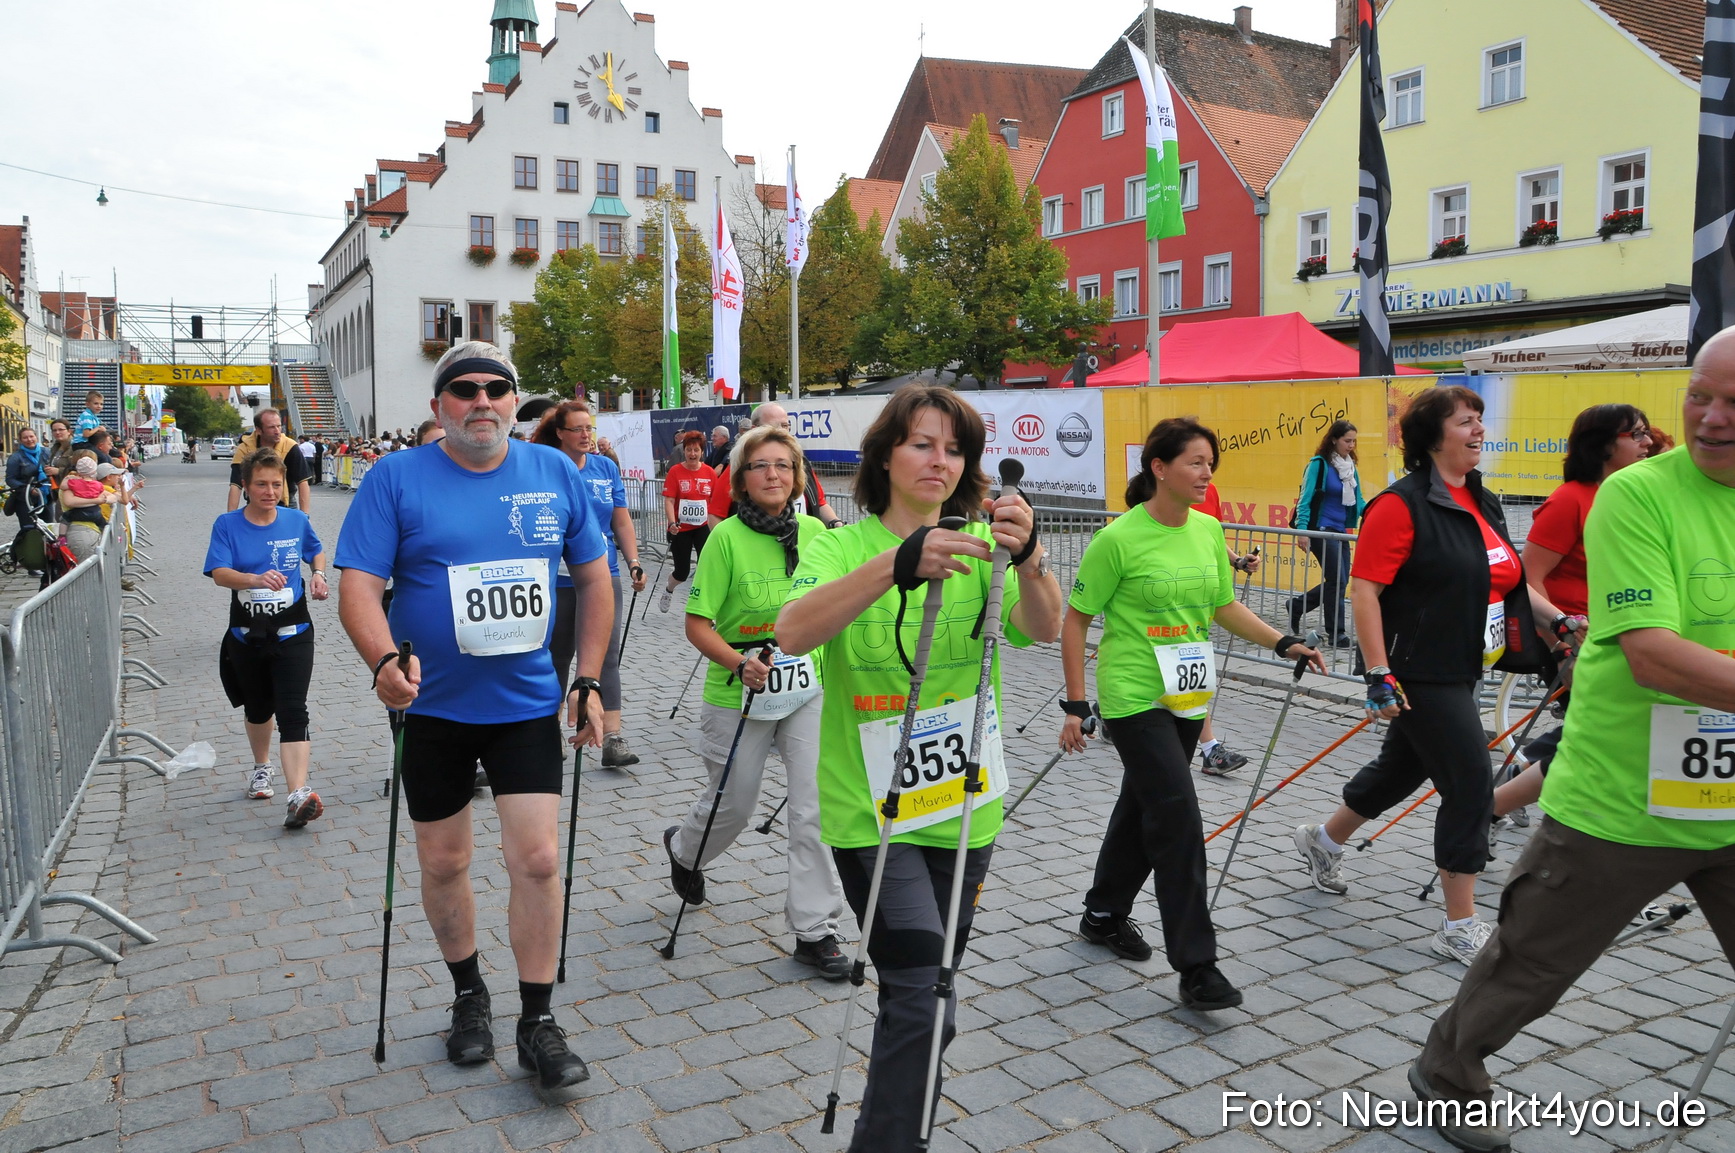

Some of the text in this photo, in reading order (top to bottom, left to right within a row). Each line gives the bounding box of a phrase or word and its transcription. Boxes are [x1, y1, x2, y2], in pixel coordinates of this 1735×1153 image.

[1334, 282, 1511, 316] ZIMERMANN
[1632, 341, 1688, 357] Tuche
[1491, 350, 1546, 364] Tucher
[172, 368, 224, 380] START
[1018, 422, 1040, 436] KIA
[1276, 413, 1305, 439] für
[1008, 447, 1050, 456] KIA MOTORS
[1525, 438, 1568, 454] Liebli
[512, 492, 558, 500] NEUMARKTER
[512, 498, 551, 506] STADTLAUF
[682, 506, 704, 516] 8008
[480, 566, 524, 578] BOCK
[466, 583, 543, 622] 8066
[1606, 588, 1652, 608] FeBa
[1147, 624, 1188, 637] MERZ
[850, 664, 884, 672] Gebäude-
[755, 663, 809, 694] 075
[1176, 662, 1207, 692] 862
[894, 733, 968, 788] 853
[913, 792, 952, 812] Maria
